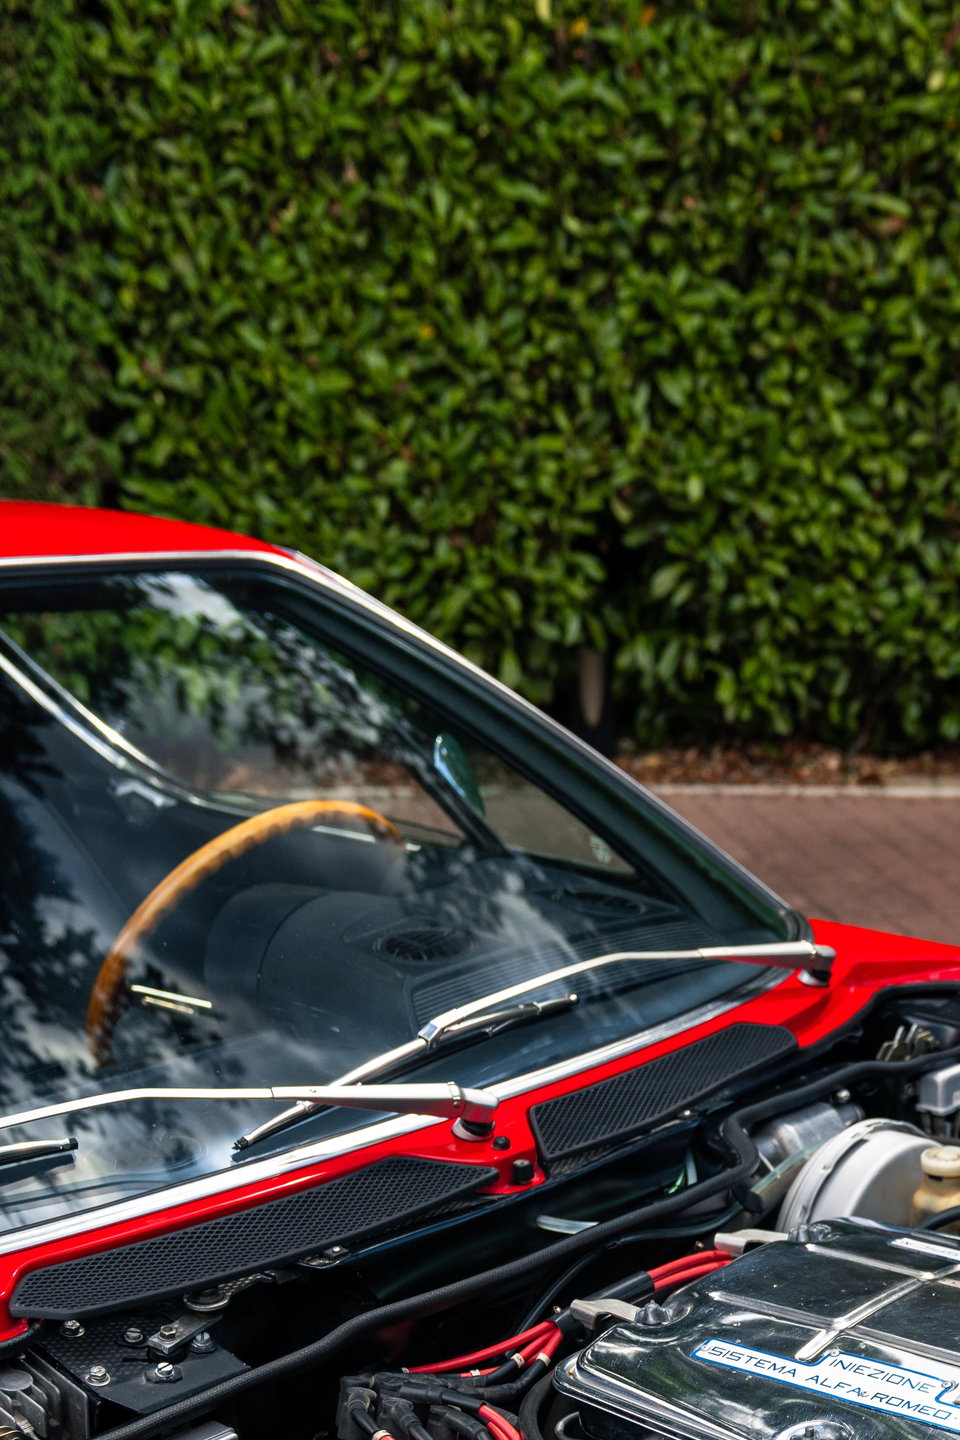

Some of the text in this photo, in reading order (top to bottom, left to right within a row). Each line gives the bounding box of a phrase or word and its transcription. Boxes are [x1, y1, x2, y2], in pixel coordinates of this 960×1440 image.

[708, 1346, 797, 1378] SISTEMA
[805, 1375, 861, 1397] ALFA
[870, 1392, 952, 1420] ROMEO
[829, 1358, 935, 1394] INIEZIONE
